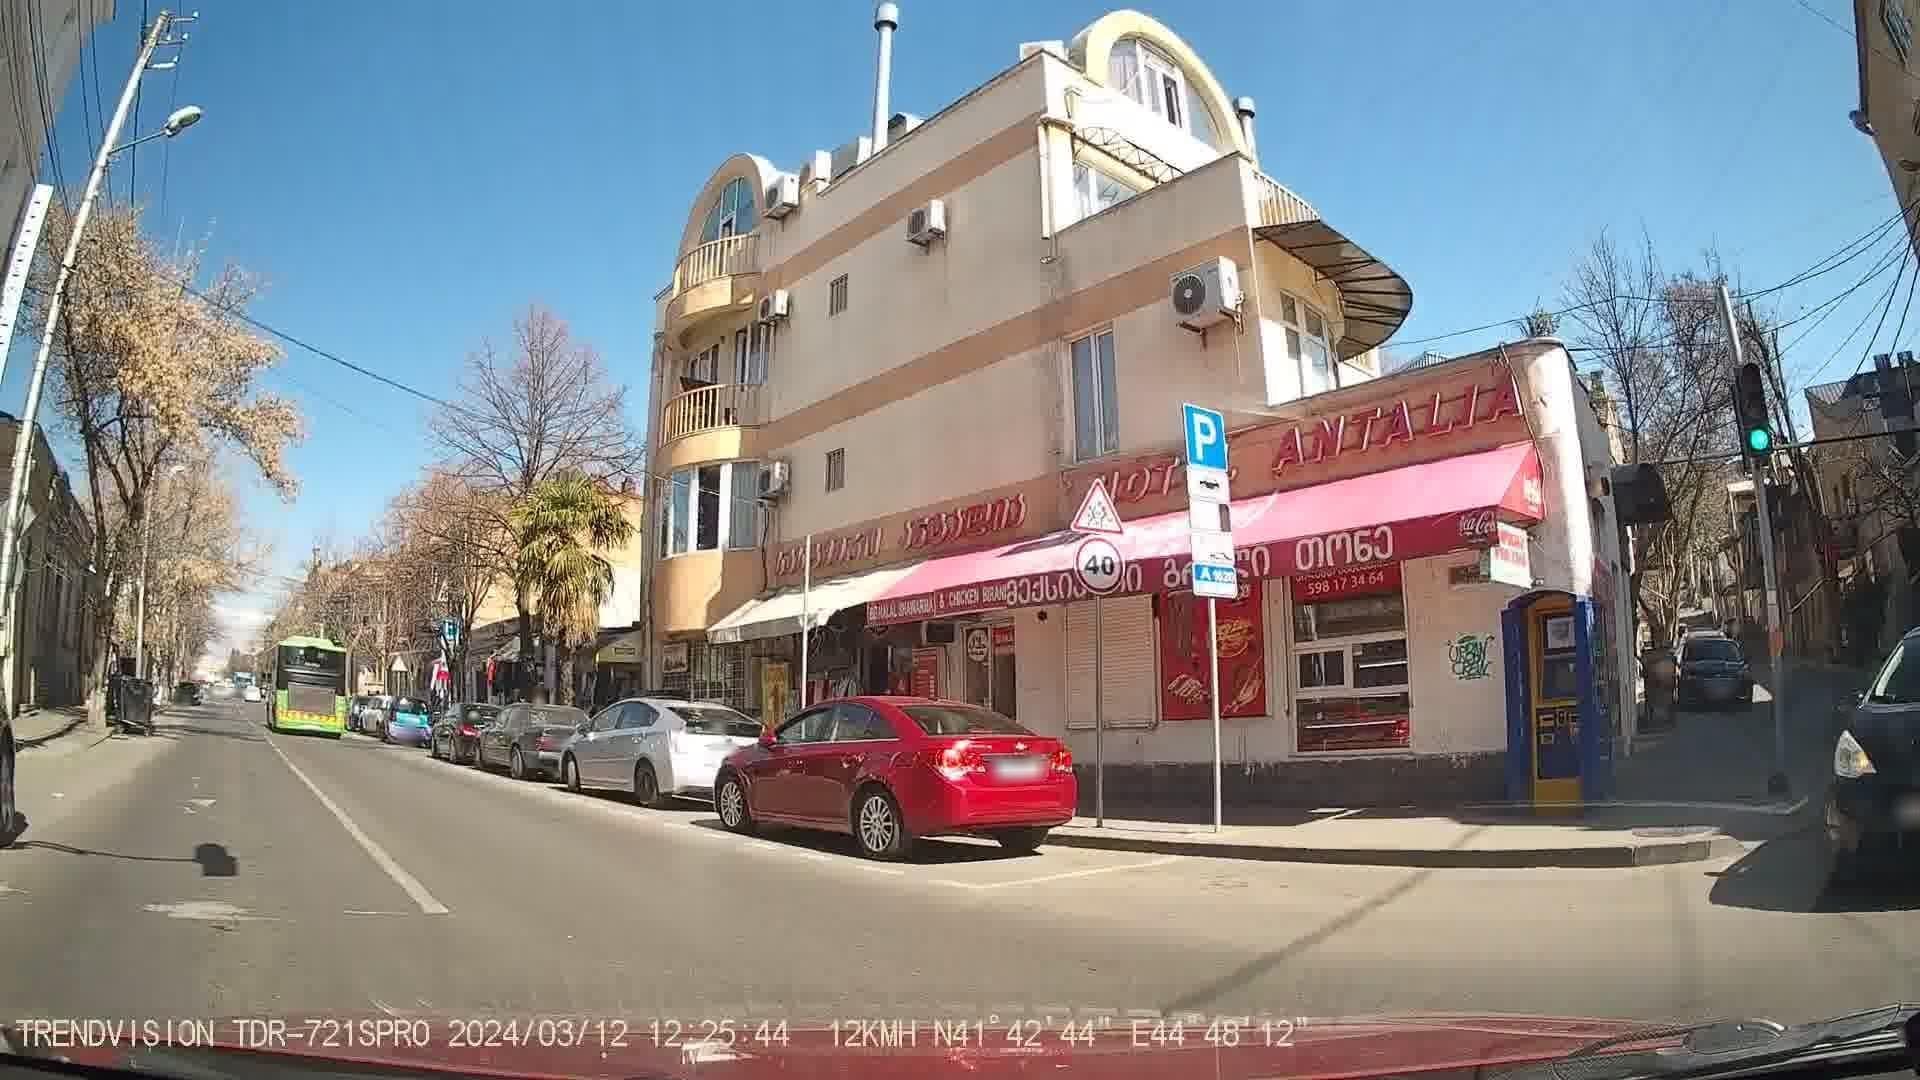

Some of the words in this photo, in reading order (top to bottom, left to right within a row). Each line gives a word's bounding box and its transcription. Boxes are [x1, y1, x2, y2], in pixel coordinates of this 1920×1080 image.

[1193, 413, 1216, 461] P
[1273, 376, 1523, 472] ANTALIA
[1085, 555, 1115, 577] 40
[1295, 525, 1393, 571] თონე
[1308, 580, 1330, 596] 598
[1333, 578, 1347, 592] 17
[1351, 575, 1365, 589] 34
[1368, 571, 1384, 585] 64
